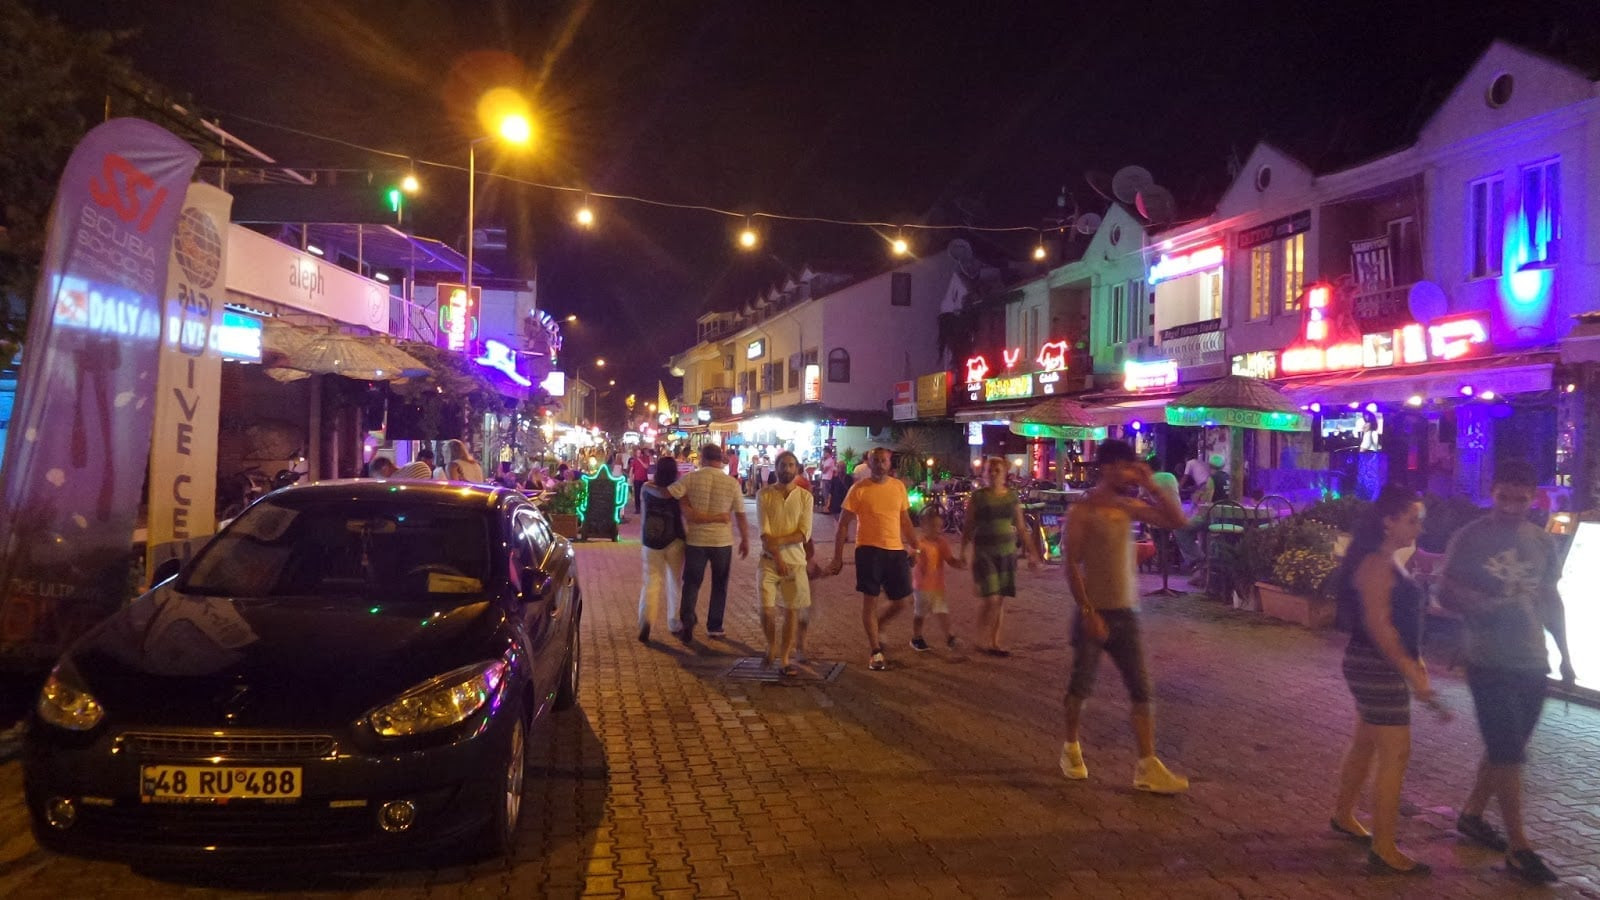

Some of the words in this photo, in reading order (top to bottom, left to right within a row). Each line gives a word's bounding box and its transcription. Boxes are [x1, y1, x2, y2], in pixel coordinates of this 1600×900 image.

[88, 153, 168, 233] SSI
[80, 205, 156, 266] SCUBA
[289, 257, 325, 299] aleph
[1227, 409, 1262, 425] ROCK
[155, 770, 188, 794] 48
[200, 770, 234, 794] RU
[245, 771, 295, 795] 488
